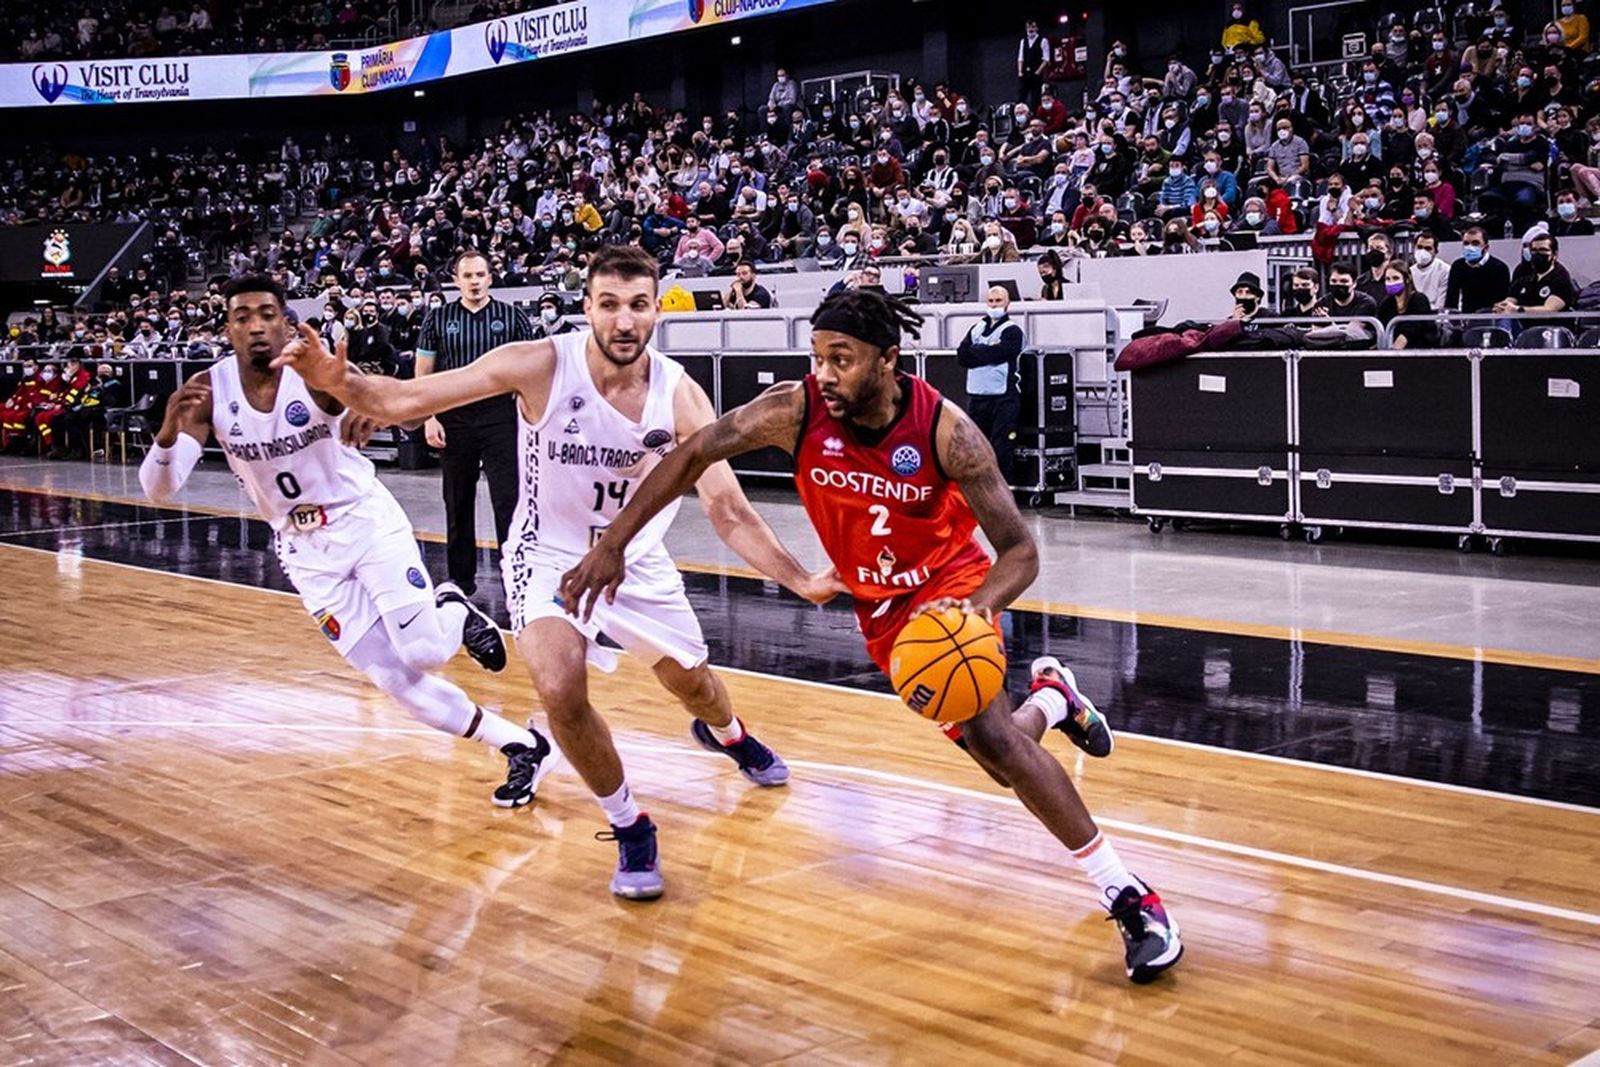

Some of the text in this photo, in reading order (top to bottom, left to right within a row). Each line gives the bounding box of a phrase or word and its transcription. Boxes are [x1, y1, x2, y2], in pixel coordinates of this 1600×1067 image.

[514, 6, 587, 43] VISIT CLUJ
[79, 63, 189, 87] VISIT CLUJ
[97, 88, 121, 100] Heart
[123, 87, 132, 100] of
[134, 85, 190, 100] Transylvania
[276, 471, 302, 499] 0
[593, 479, 629, 512] 14
[810, 467, 934, 503] OOSTENDE
[297, 510, 318, 525] BT
[868, 504, 892, 536] 2
